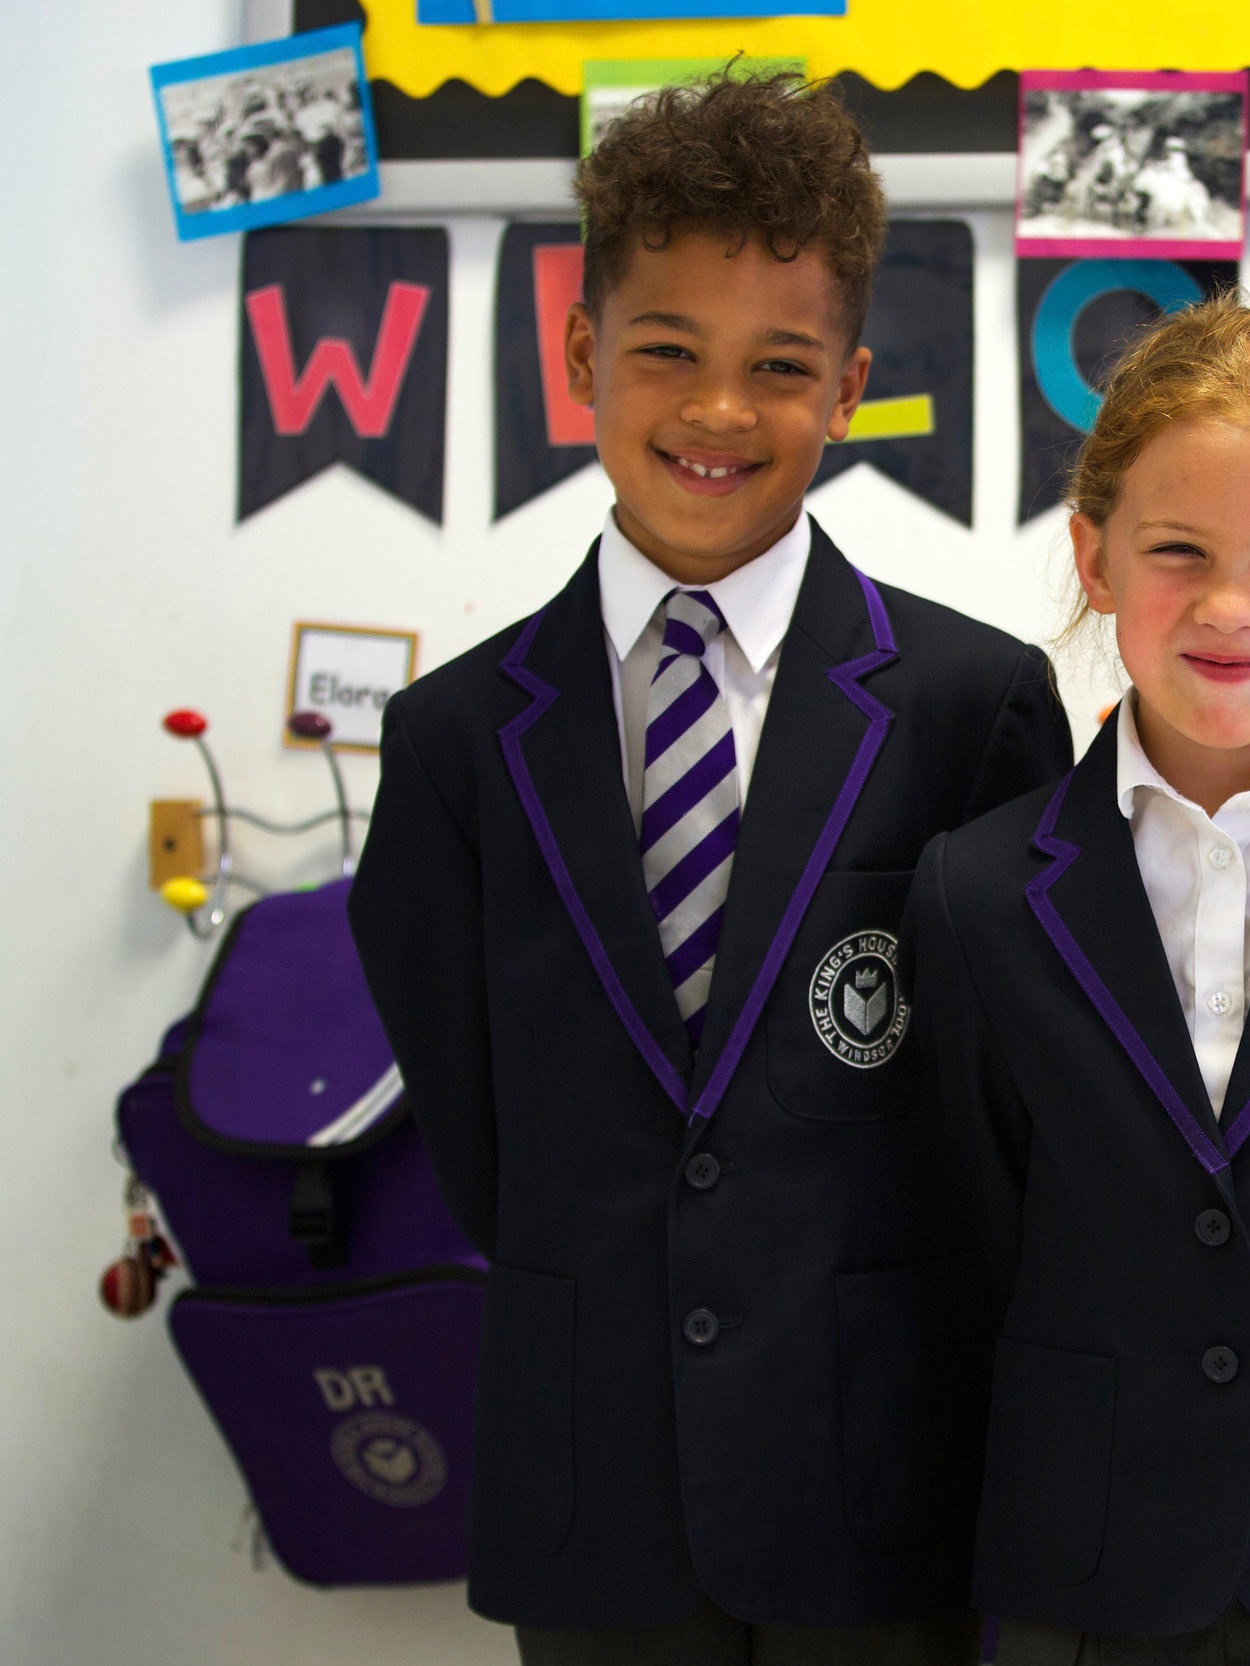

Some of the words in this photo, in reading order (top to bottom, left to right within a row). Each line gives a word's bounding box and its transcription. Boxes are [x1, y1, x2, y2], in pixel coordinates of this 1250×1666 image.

[814, 944, 854, 1001] KING'S
[815, 1007, 837, 1044] THE
[837, 1039, 894, 1063] WINDSOR
[312, 1366, 395, 1411] DR
